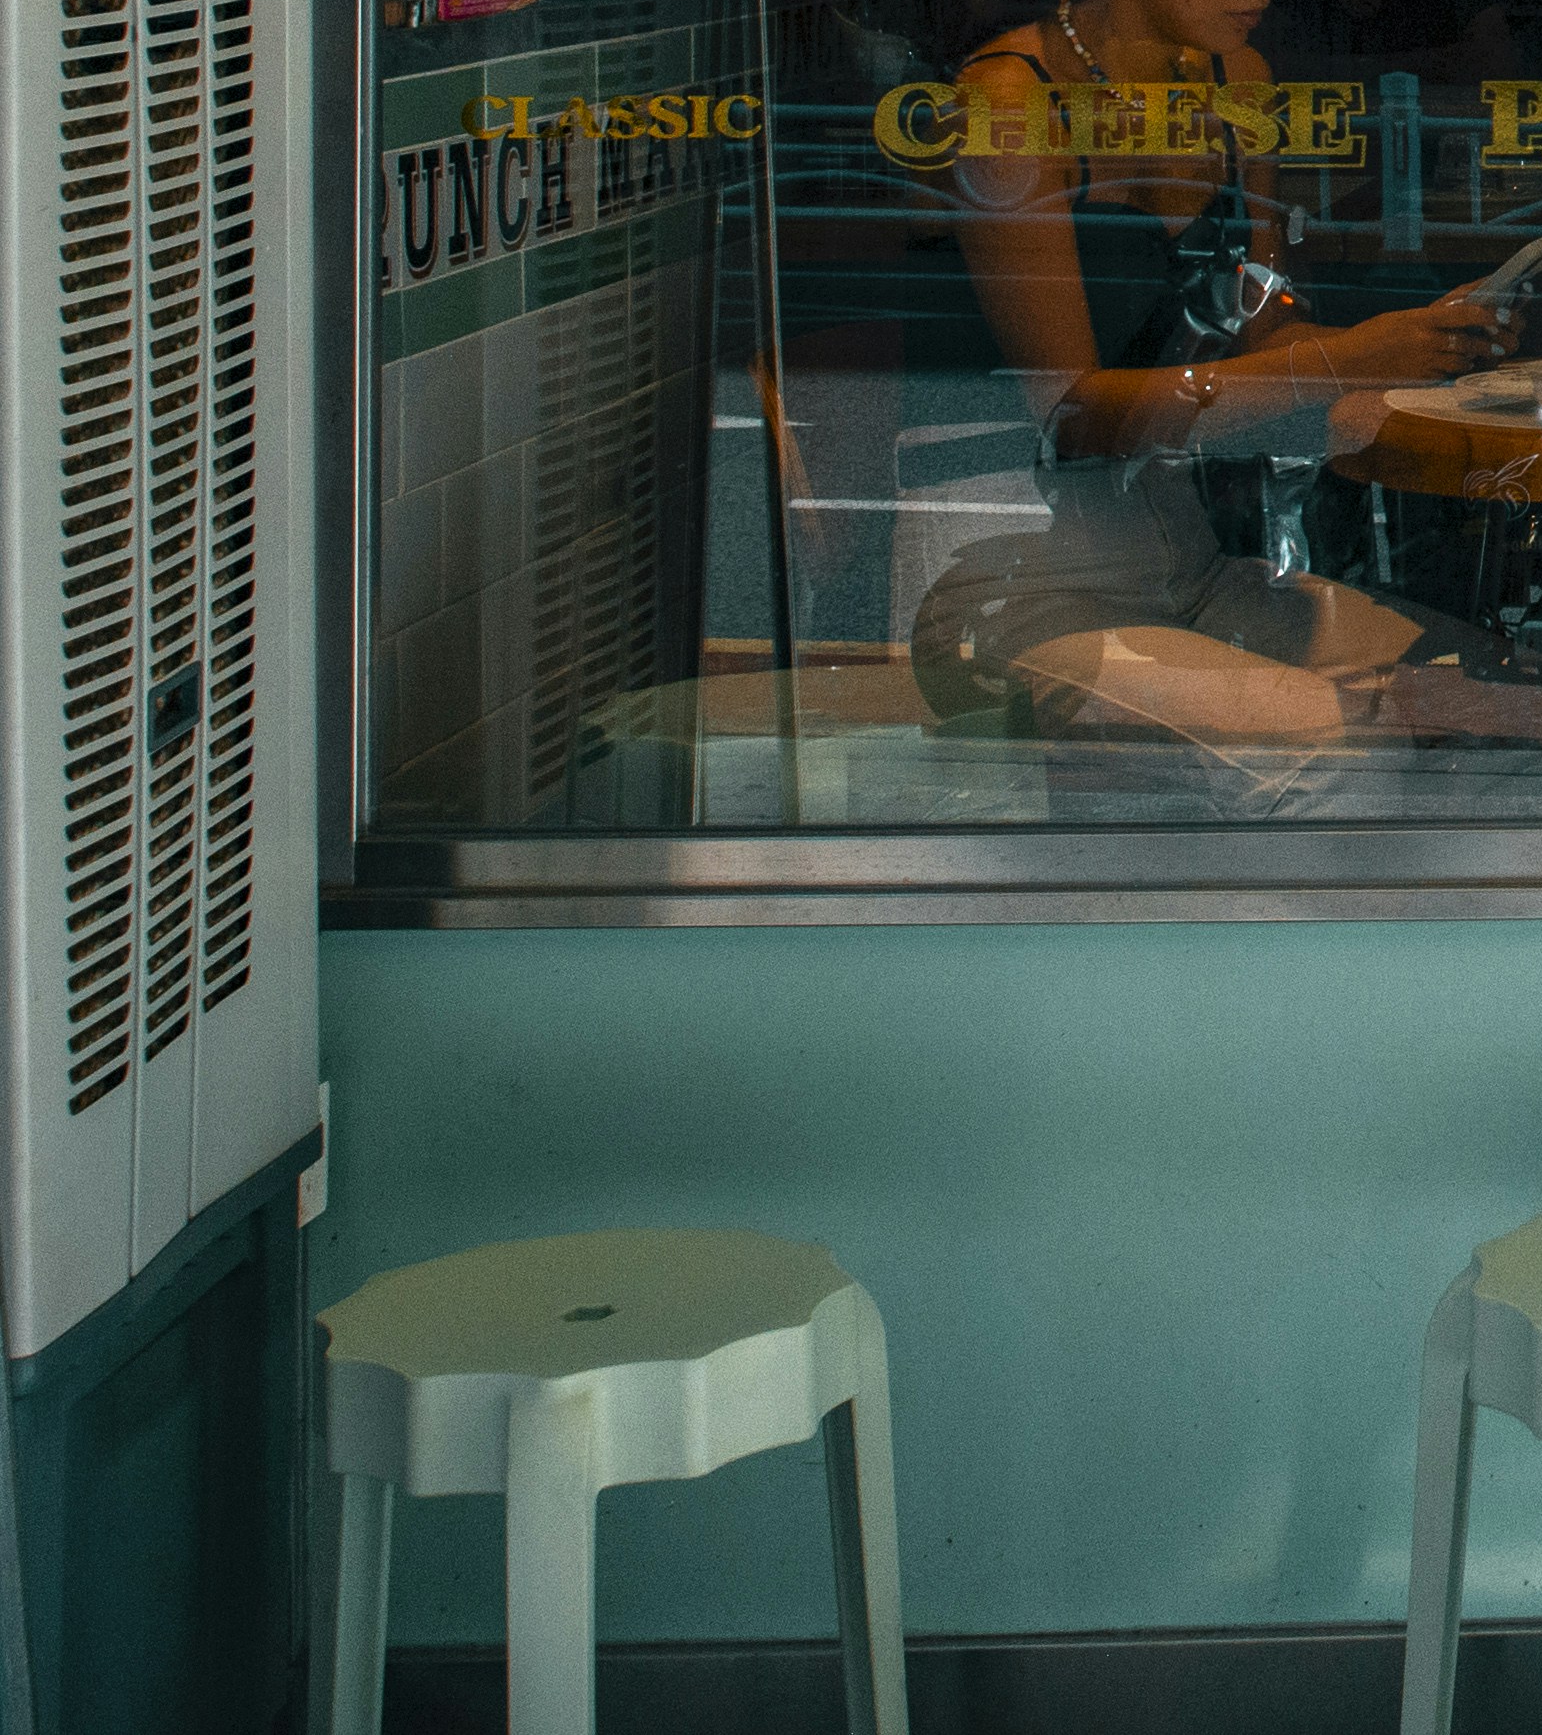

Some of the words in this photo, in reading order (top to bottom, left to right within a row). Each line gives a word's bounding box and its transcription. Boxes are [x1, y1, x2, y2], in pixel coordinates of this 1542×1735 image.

[461, 93, 765, 142] CLASSIC
[873, 80, 1369, 172] CHEESE
[382, 120, 574, 289] UNCH
